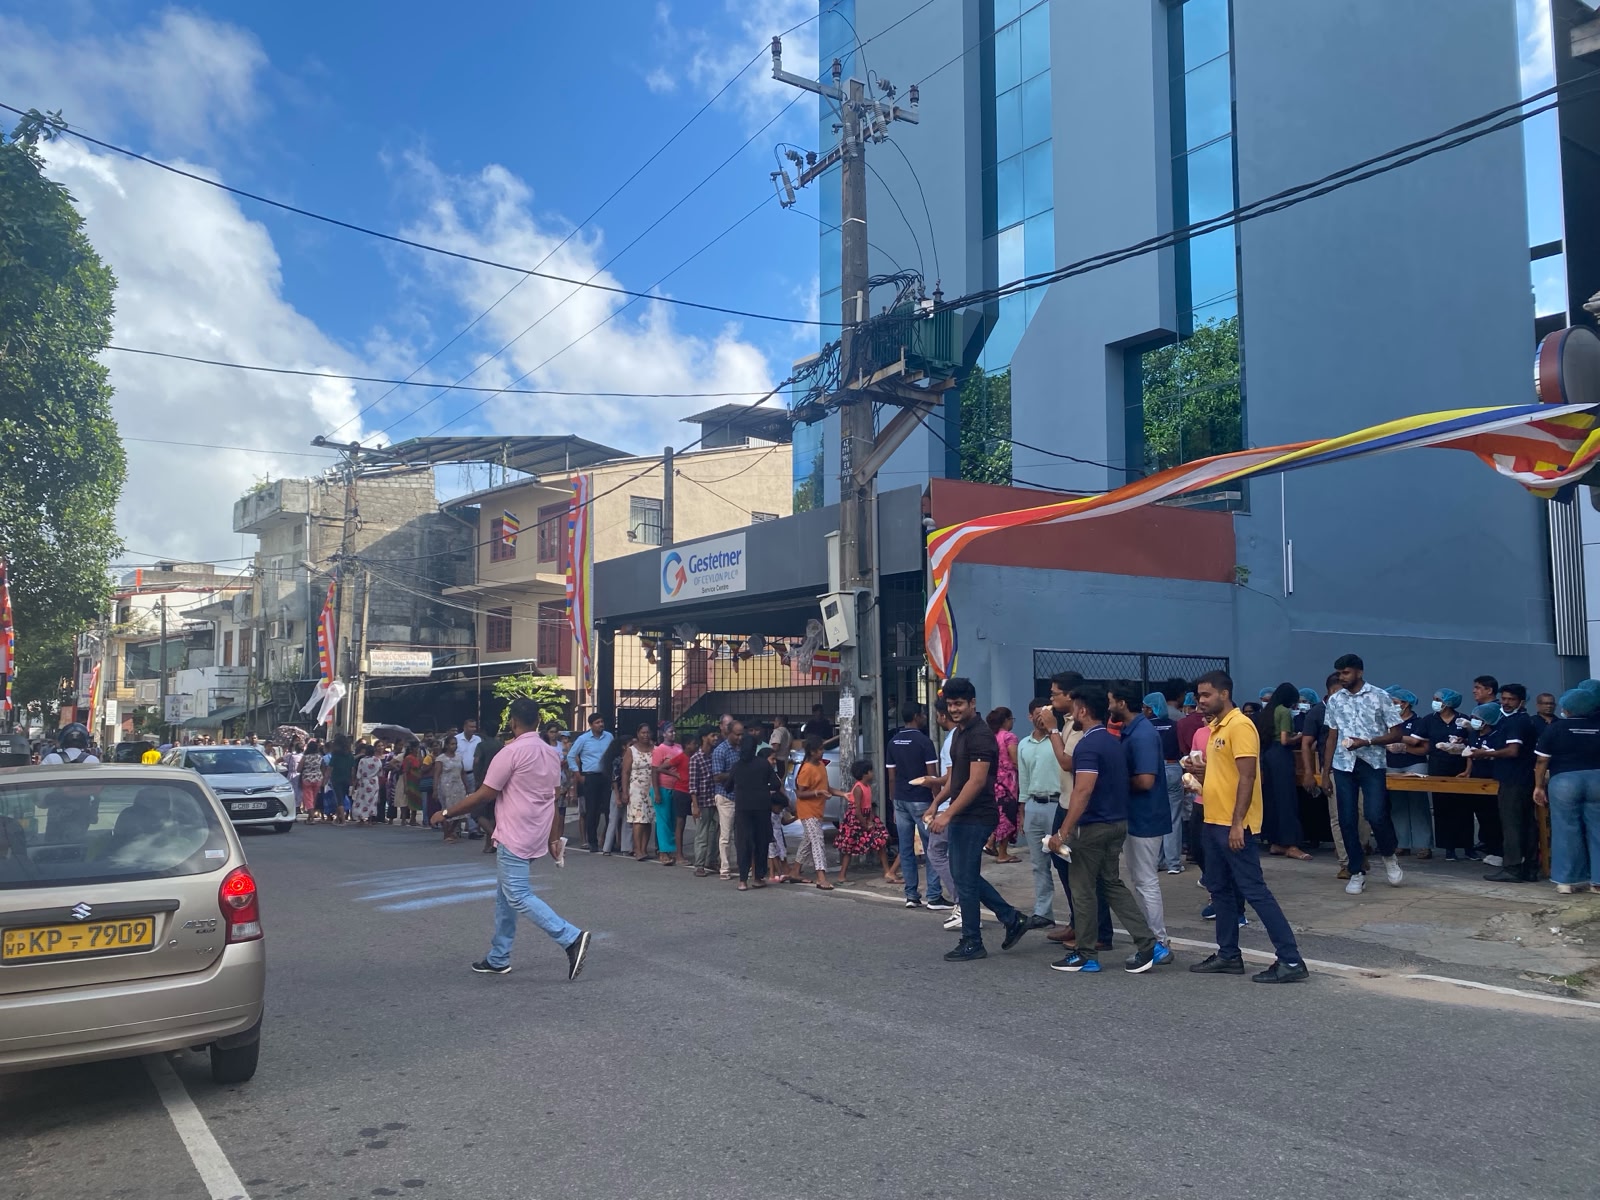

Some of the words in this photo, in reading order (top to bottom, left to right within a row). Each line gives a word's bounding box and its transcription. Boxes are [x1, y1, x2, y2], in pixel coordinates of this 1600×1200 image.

[689, 549, 741, 573] Gestetner
[702, 572, 724, 584] CEYLON
[701, 586, 716, 594] Service
[181, 918, 217, 929] ALTO
[5, 942, 26, 956] WP
